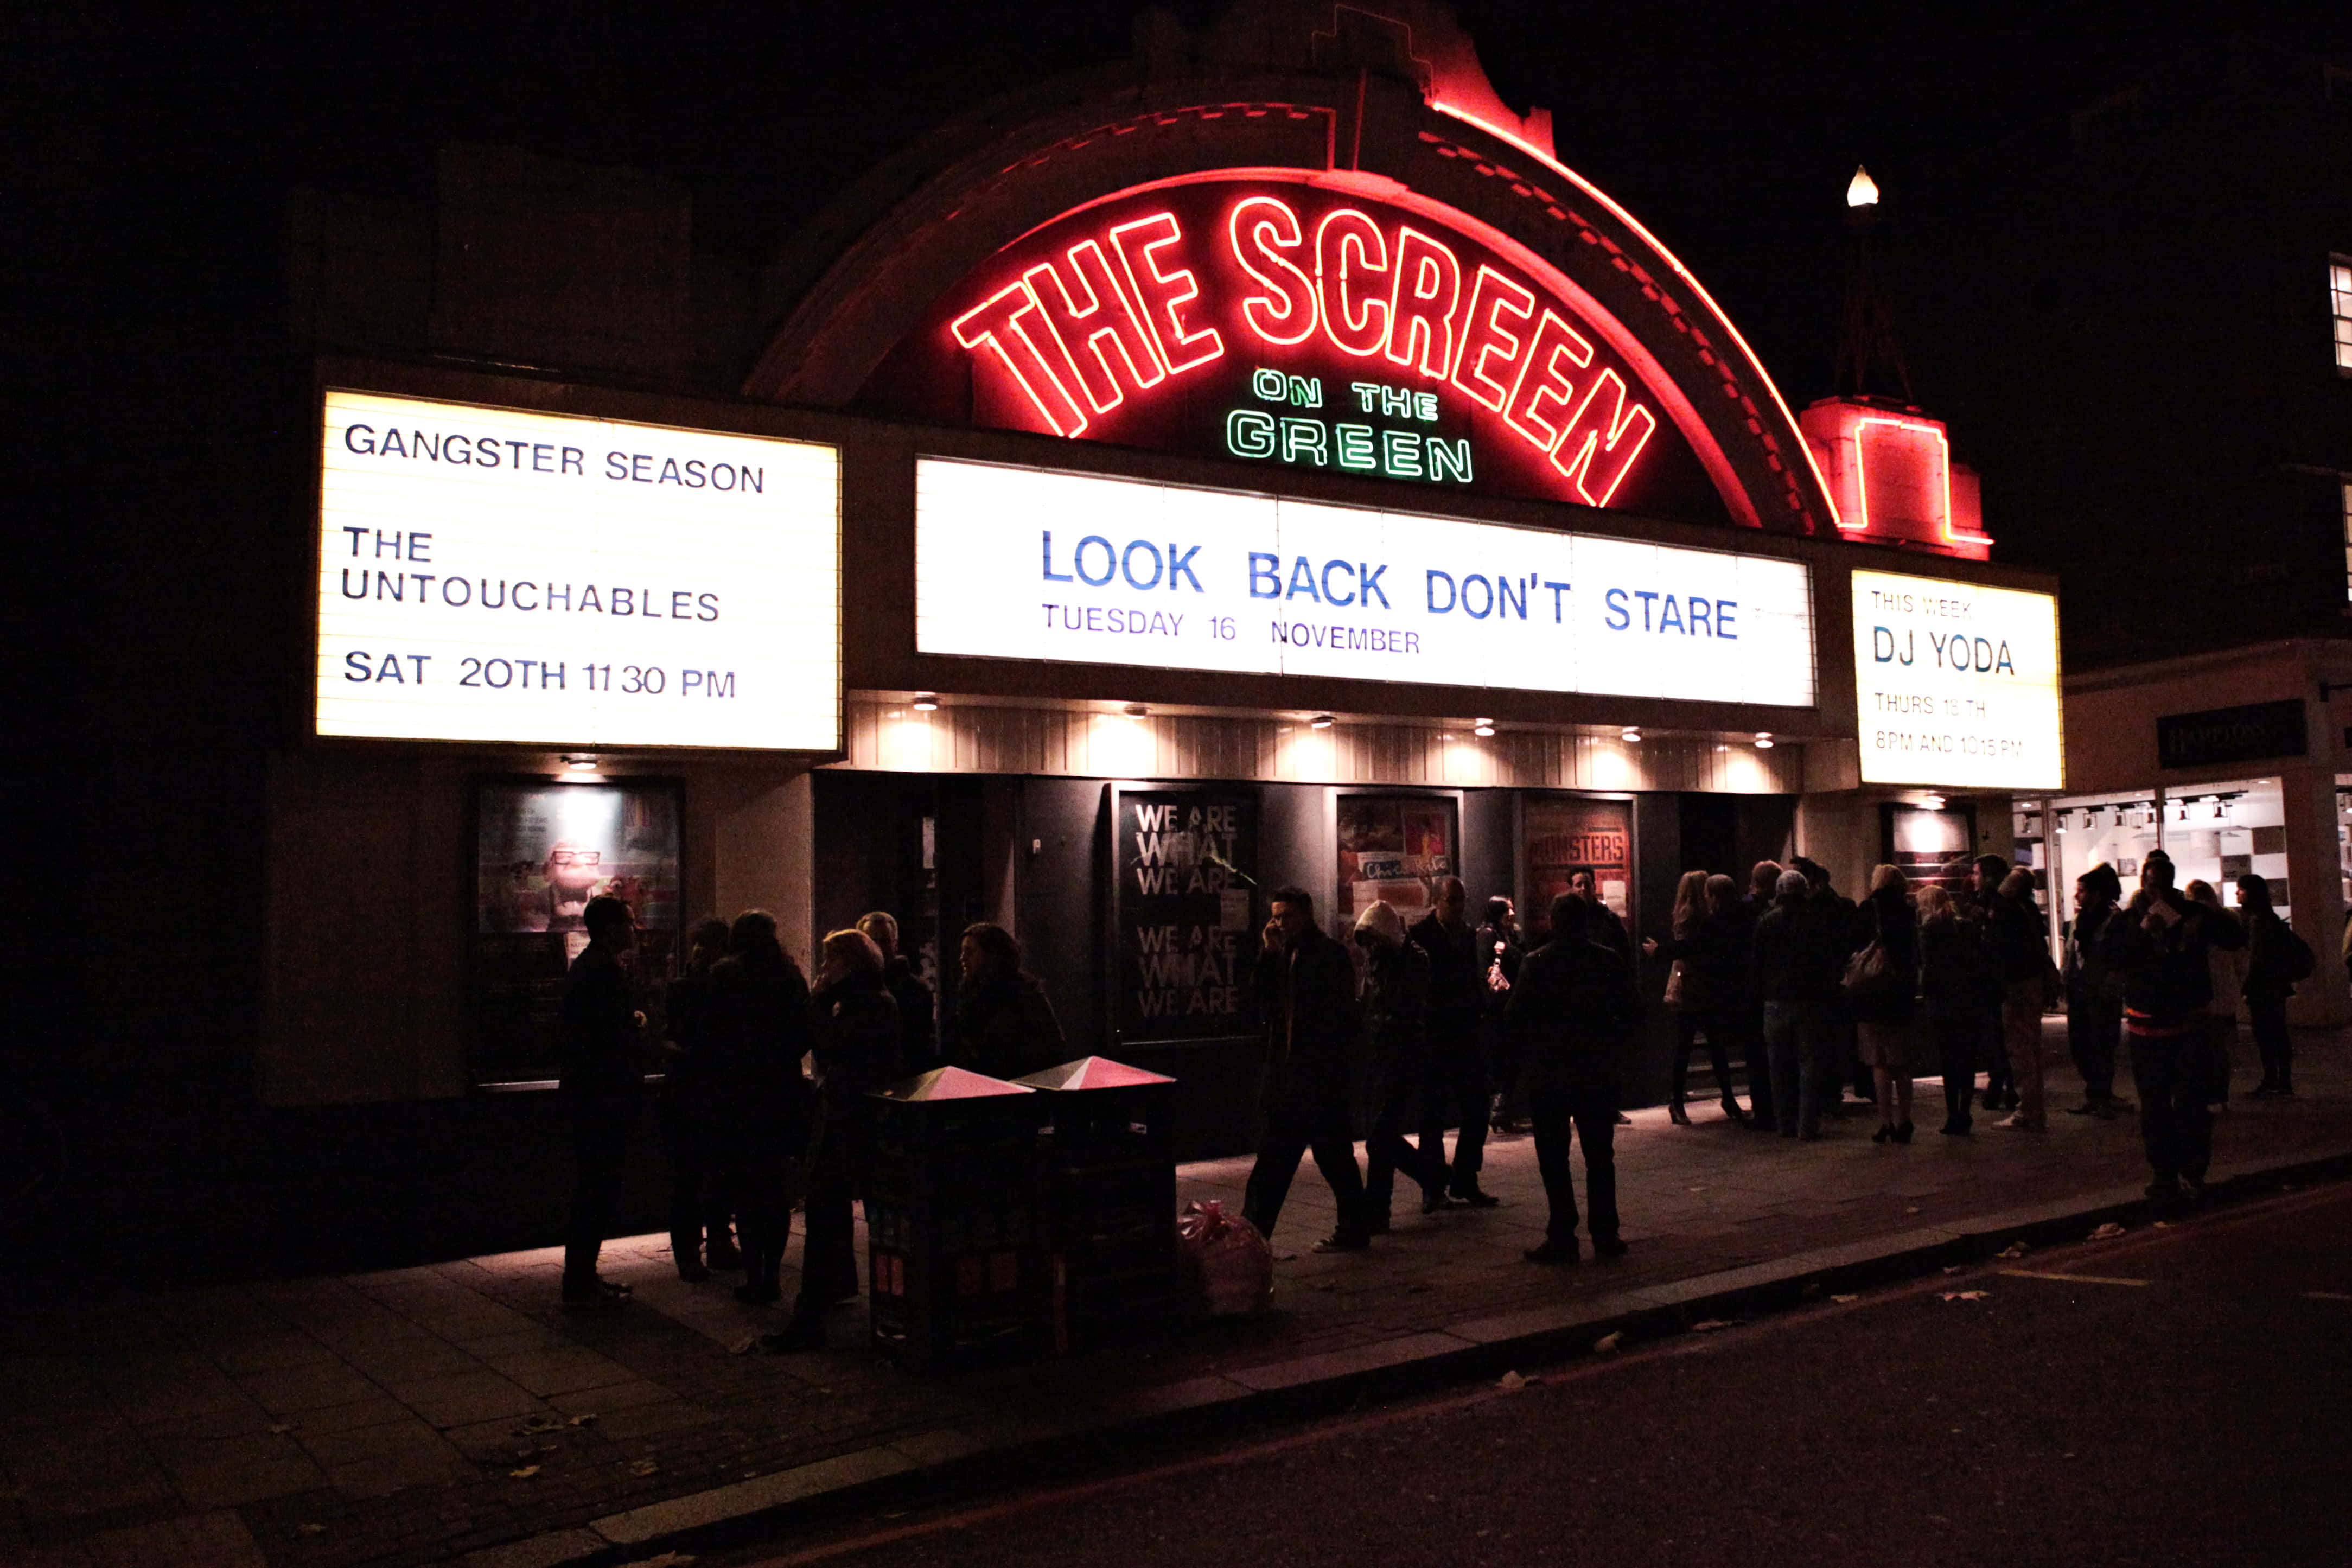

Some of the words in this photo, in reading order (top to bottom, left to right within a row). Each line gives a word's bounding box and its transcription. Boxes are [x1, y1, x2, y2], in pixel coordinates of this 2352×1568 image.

[951, 212, 1225, 438] THE
[1229, 196, 1656, 507] SCREEN
[1253, 368, 1323, 408] ON
[1351, 382, 1439, 422] THE
[345, 423, 584, 475] GANGSTER
[605, 451, 763, 493] SEASON
[1226, 409, 1473, 483] GREEN
[342, 526, 432, 563] THE
[341, 568, 719, 622] UNTOUCHABLES
[1042, 530, 1204, 593] LOOK
[1248, 551, 1391, 610] BACK
[1426, 569, 1571, 624] DON'T
[1604, 588, 1738, 640] STARE
[1872, 591, 1913, 612] THIS
[1922, 596, 1973, 620] WEEK
[1042, 603, 1183, 636] TUESDAY
[1209, 616, 1237, 641] 16
[1272, 621, 1420, 654] NOVEMBER
[1873, 626, 1914, 666] DJ
[1929, 632, 2015, 675] YODA
[344, 651, 432, 685] SAT
[459, 657, 565, 690] 20TH
[682, 670, 735, 698] PM
[1875, 692, 1933, 714] THURS
[1920, 734, 1953, 752] AND
[1136, 804, 1178, 833] WE
[1188, 805, 1238, 833] ARE
[1136, 832, 1238, 867] WHAT
[1136, 868, 1178, 895] WE
[1137, 925, 1178, 954] WE
[1138, 954, 1238, 988] WHAT
[1137, 989, 1178, 1017] WE
[1186, 986, 1238, 1016] ARE
